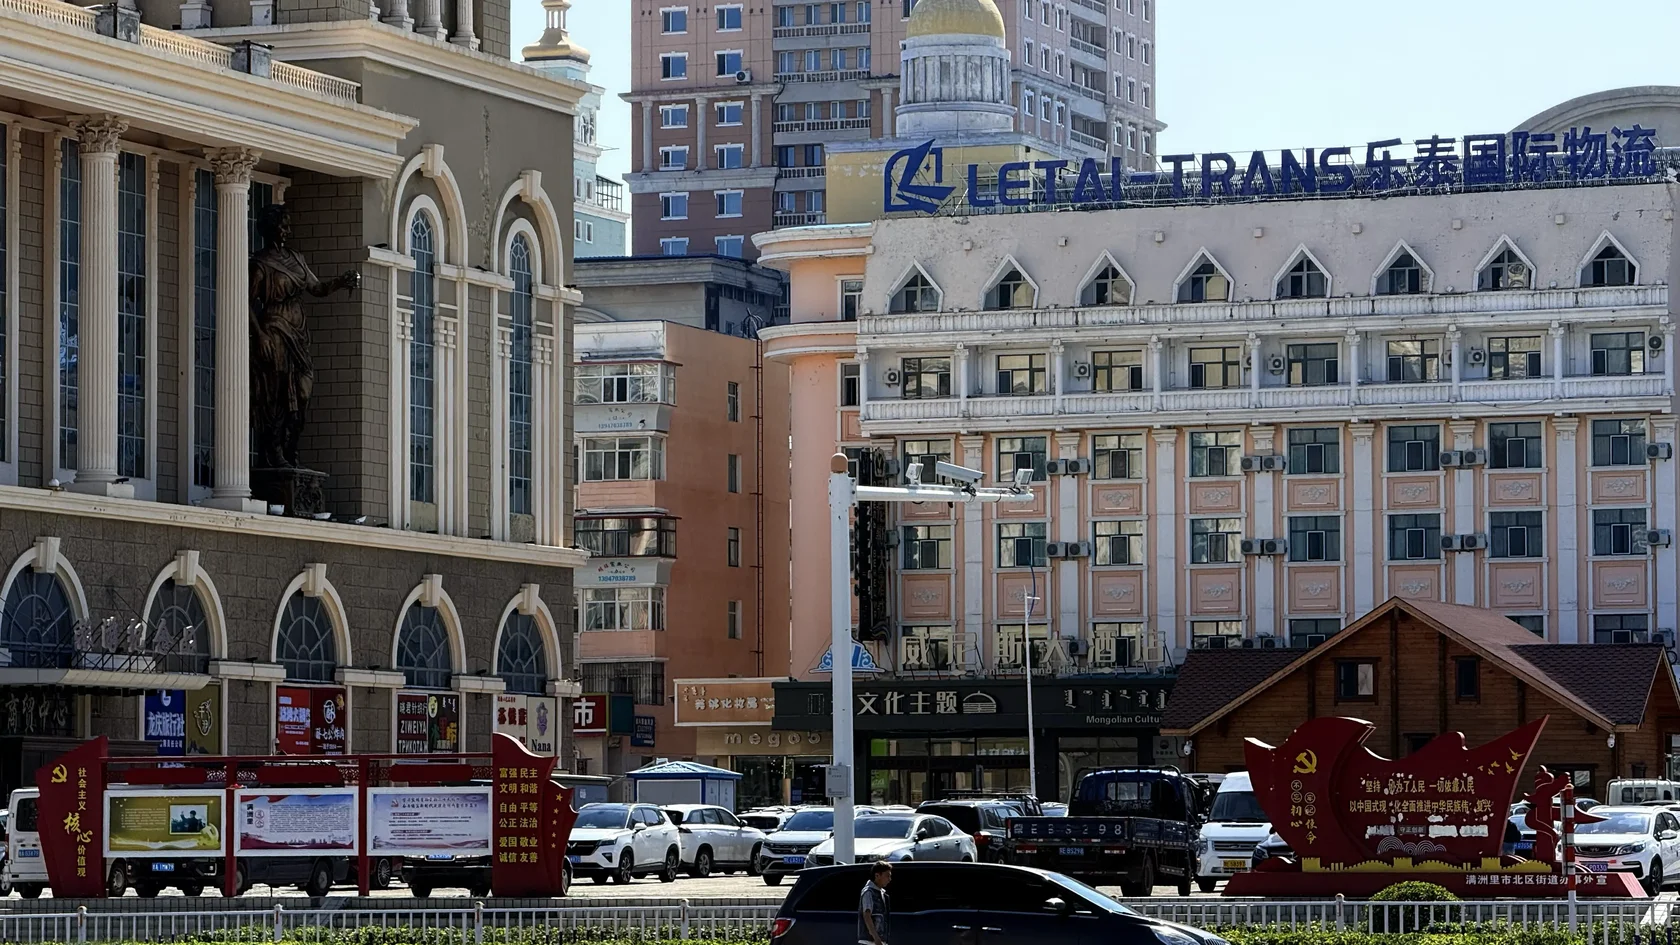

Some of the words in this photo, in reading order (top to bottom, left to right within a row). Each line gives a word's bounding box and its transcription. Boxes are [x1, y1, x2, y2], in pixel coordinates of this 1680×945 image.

[1366, 123, 1657, 194] 乐泰国际物流
[974, 665, 1012, 676] Venice
[1058, 664, 1090, 675] Hotel
[856, 691, 958, 715] 文化主题
[573, 698, 596, 727] 市
[1086, 715, 1133, 726] Mongolian
[531, 739, 551, 752] Nana
